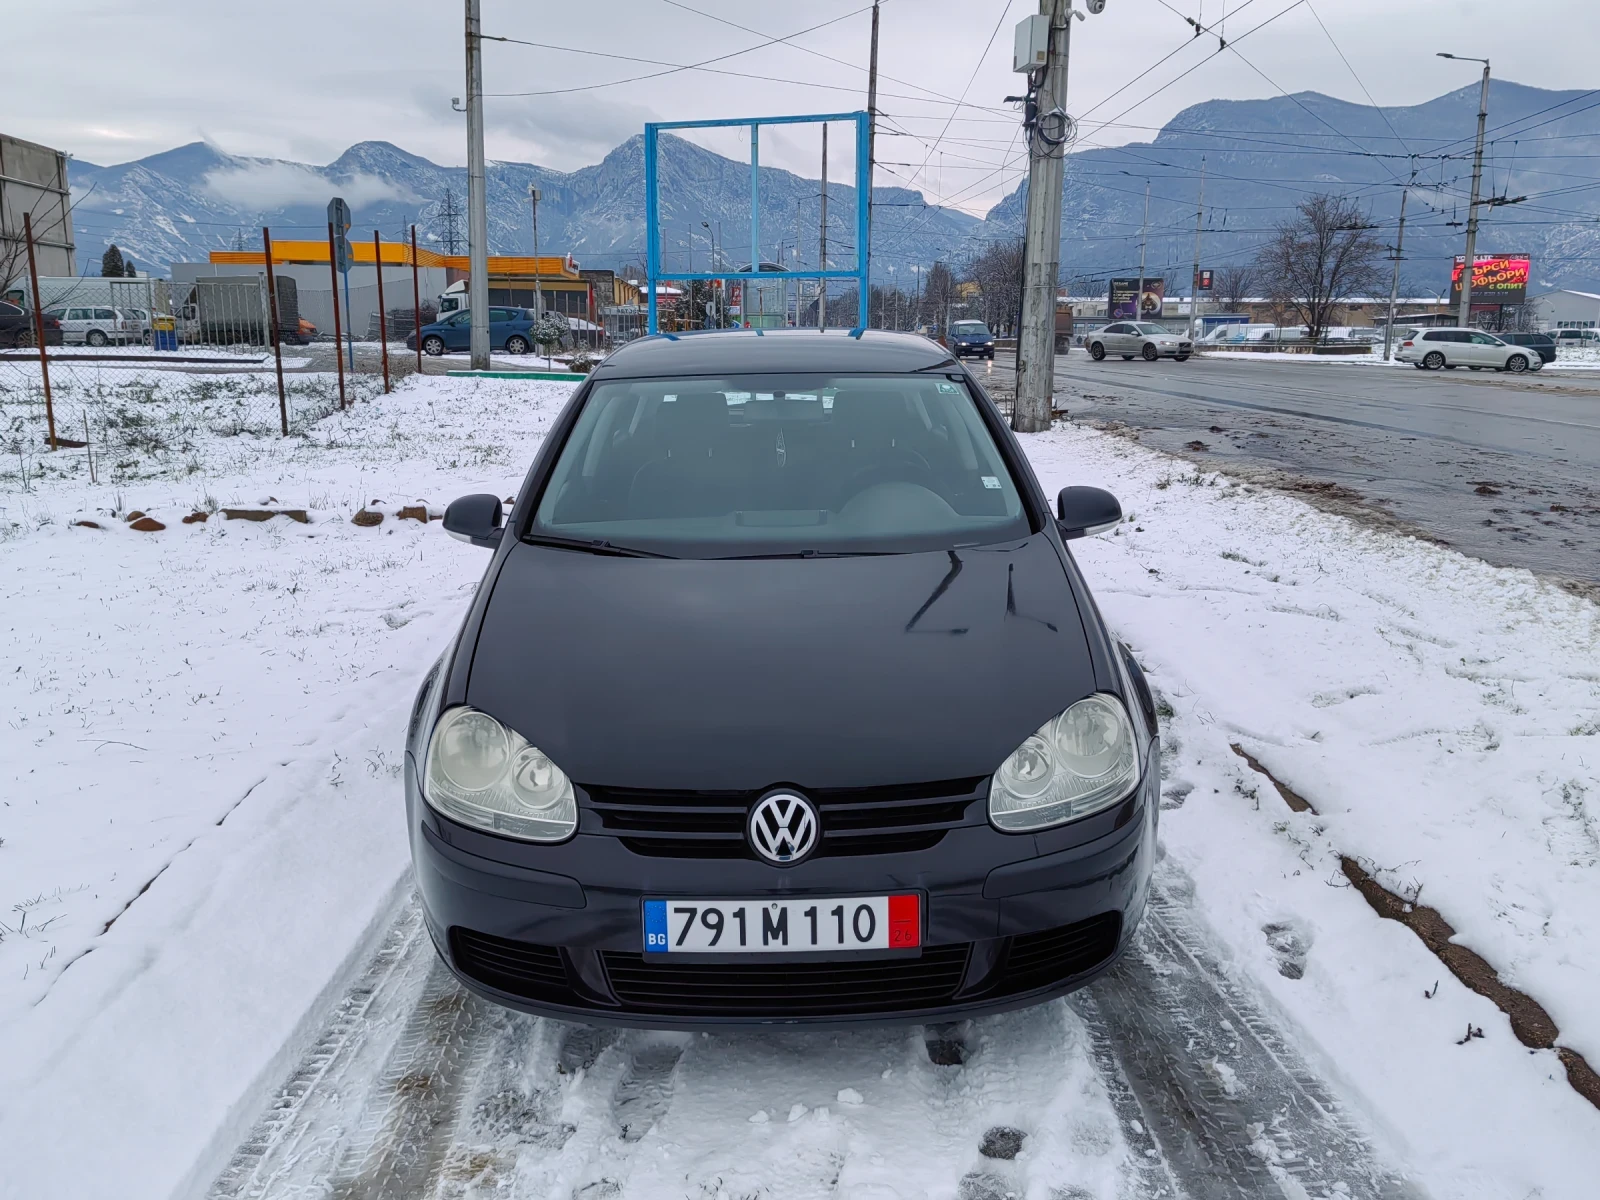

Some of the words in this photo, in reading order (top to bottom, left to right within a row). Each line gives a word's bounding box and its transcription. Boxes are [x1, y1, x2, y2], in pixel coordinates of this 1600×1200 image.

[1470, 259, 1509, 275] ЪРСИ
[752, 794, 817, 862] VW
[648, 933, 666, 945] BG
[893, 929, 912, 942] 26
